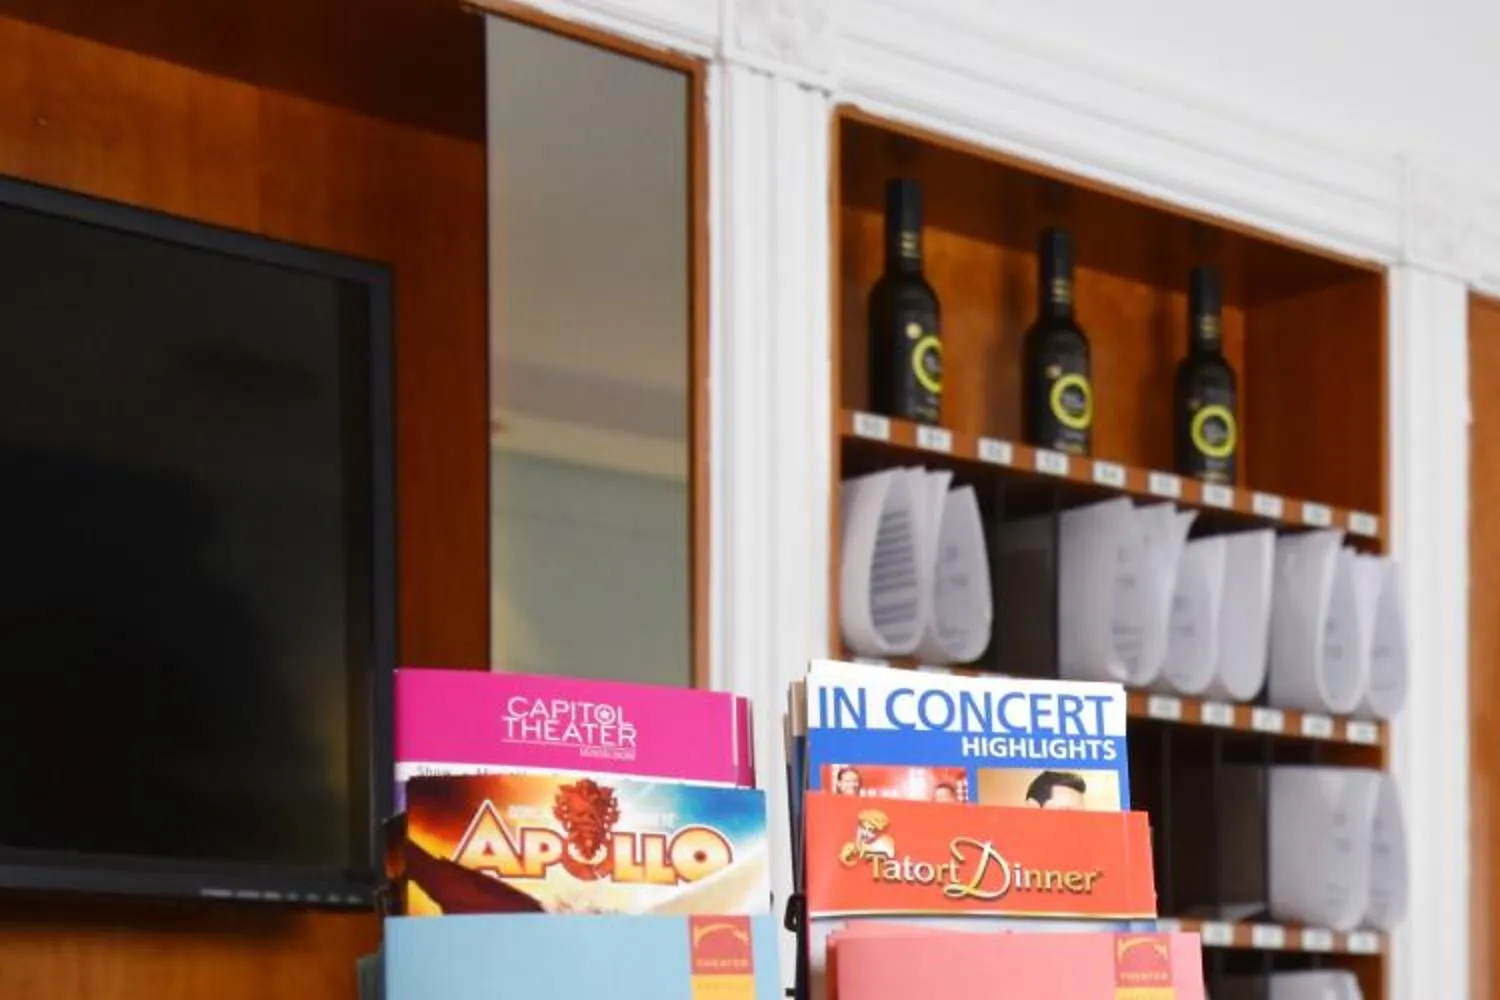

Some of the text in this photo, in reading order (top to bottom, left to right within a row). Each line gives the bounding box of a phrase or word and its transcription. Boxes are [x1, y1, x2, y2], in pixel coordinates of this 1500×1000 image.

[502, 715, 638, 747] THEATER
[506, 695, 632, 727] CAPITOL
[818, 685, 867, 729] IN
[885, 687, 1113, 736] CONCERT
[962, 737, 1117, 761] HIGHLIGHTS
[451, 799, 734, 886] APOLLO
[867, 836, 1102, 899] Tatort Dinner
